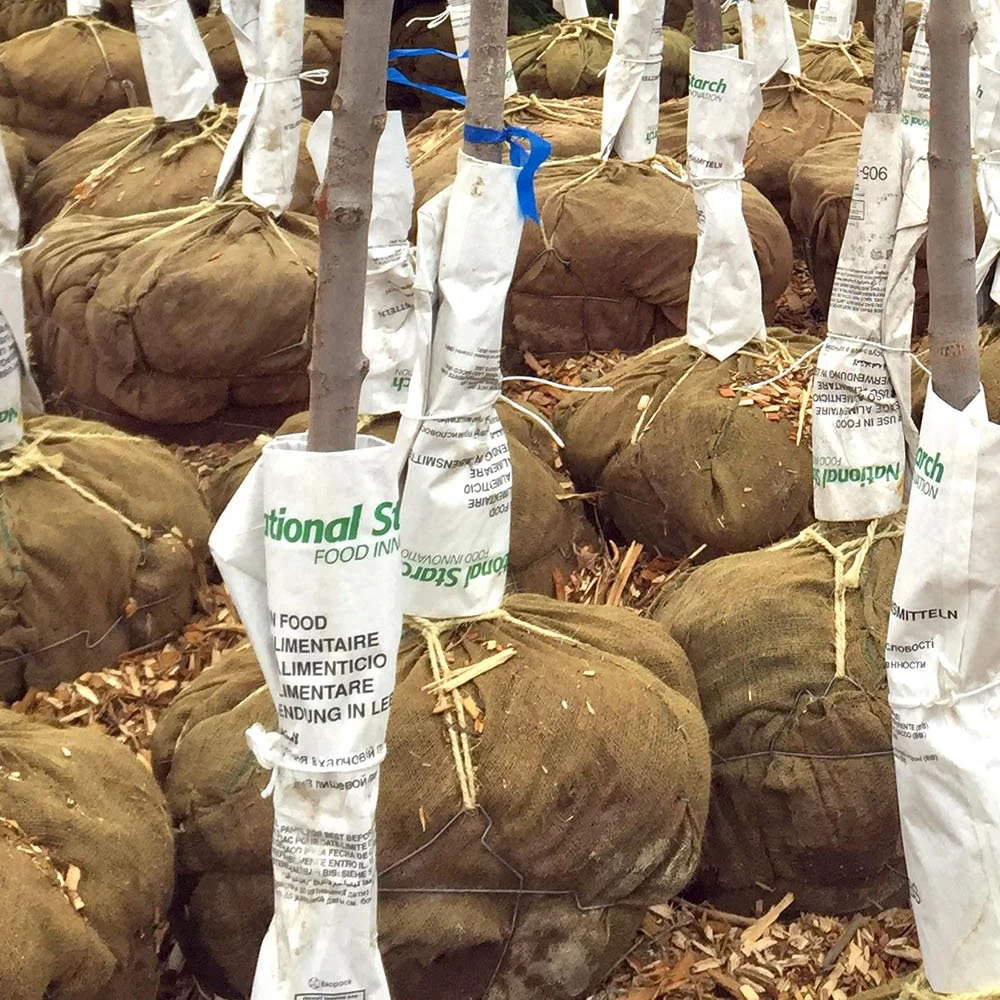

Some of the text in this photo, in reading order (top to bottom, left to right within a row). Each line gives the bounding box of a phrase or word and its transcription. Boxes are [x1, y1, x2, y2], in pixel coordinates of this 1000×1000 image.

[689, 73, 727, 94] tarch
[835, 416, 896, 429] USE IN FOOD
[822, 462, 900, 488] National
[314, 544, 369, 565] FOOD
[280, 613, 328, 630] FOOD
[279, 653, 388, 676] LIMENTICIO
[347, 703, 366, 719] IN
